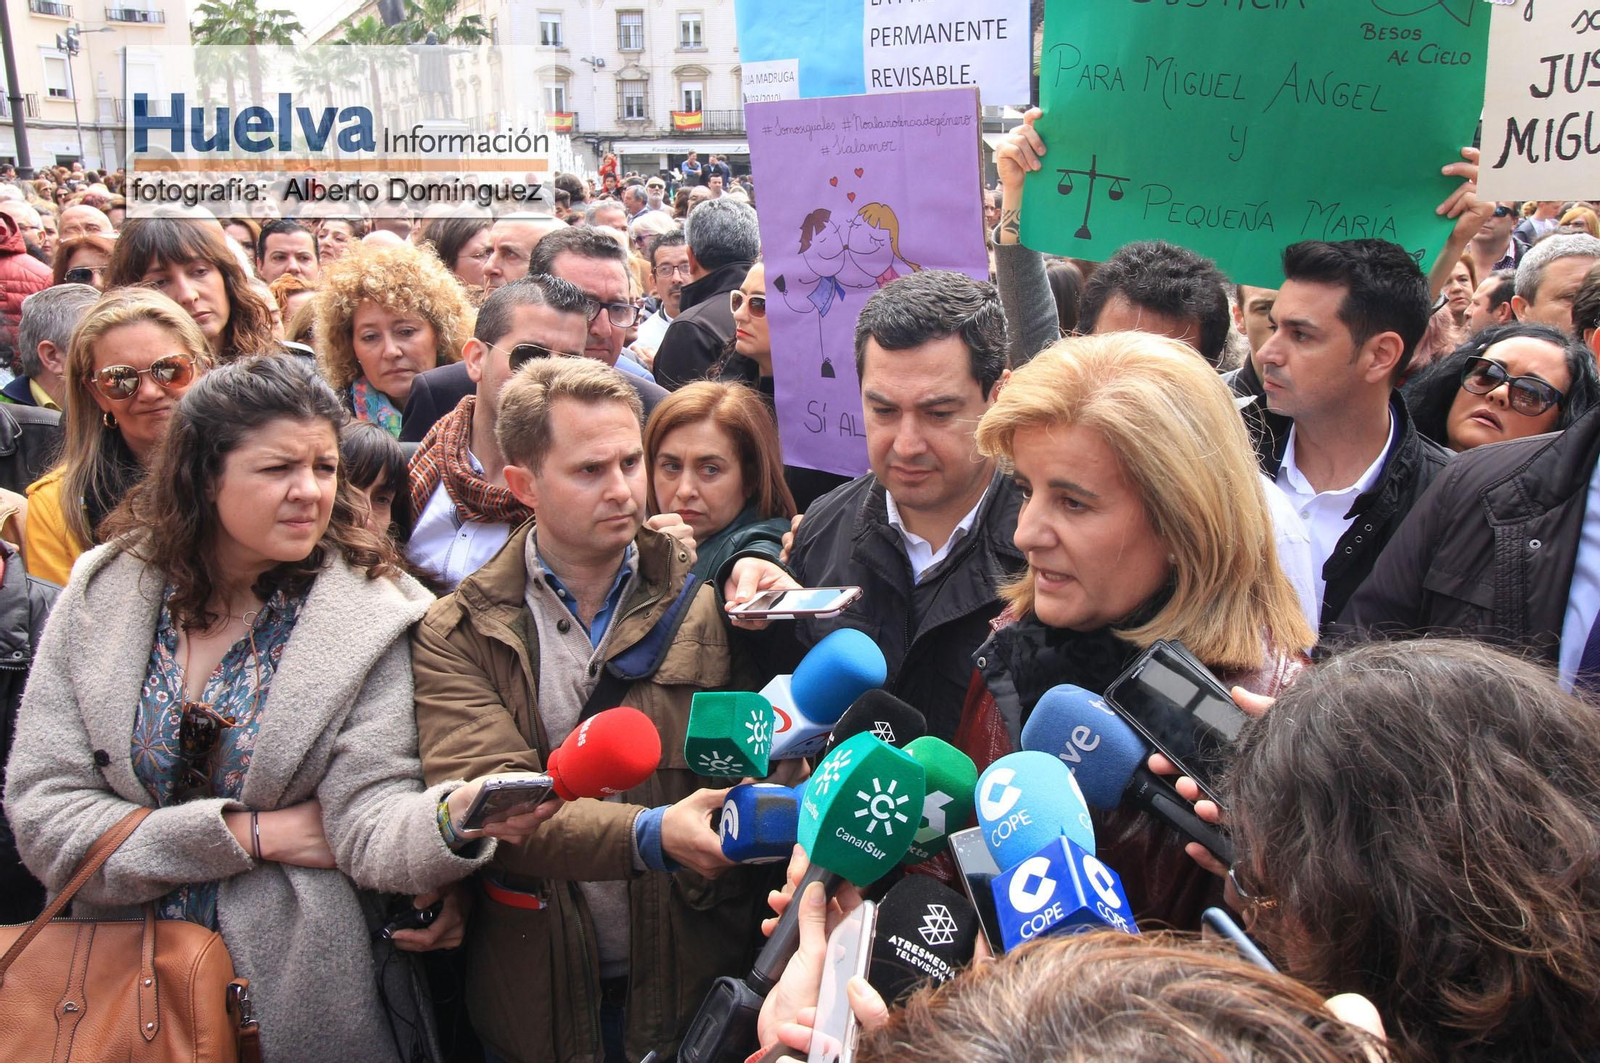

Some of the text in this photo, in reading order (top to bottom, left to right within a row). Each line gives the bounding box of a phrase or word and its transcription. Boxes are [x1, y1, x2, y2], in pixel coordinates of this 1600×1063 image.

[870, 18, 1008, 47] PERMANENTE
[1360, 23, 1422, 41] BESOS
[1387, 49, 1410, 65] AL
[755, 71, 795, 84] MADRUGA
[871, 64, 977, 88] REVISABLE.
[1049, 43, 1125, 92] PARA
[1263, 62, 1387, 113] ANGEL
[1140, 183, 1274, 233] PEQUEÑA
[839, 412, 867, 438] AL
[835, 826, 888, 861] CanalSur
[991, 809, 1033, 848] COPE
[1020, 902, 1065, 939] COPE
[1096, 901, 1130, 935] COPE
[888, 934, 957, 980] ATRESMEDIA
[895, 947, 946, 983] TELEVISIÓN
